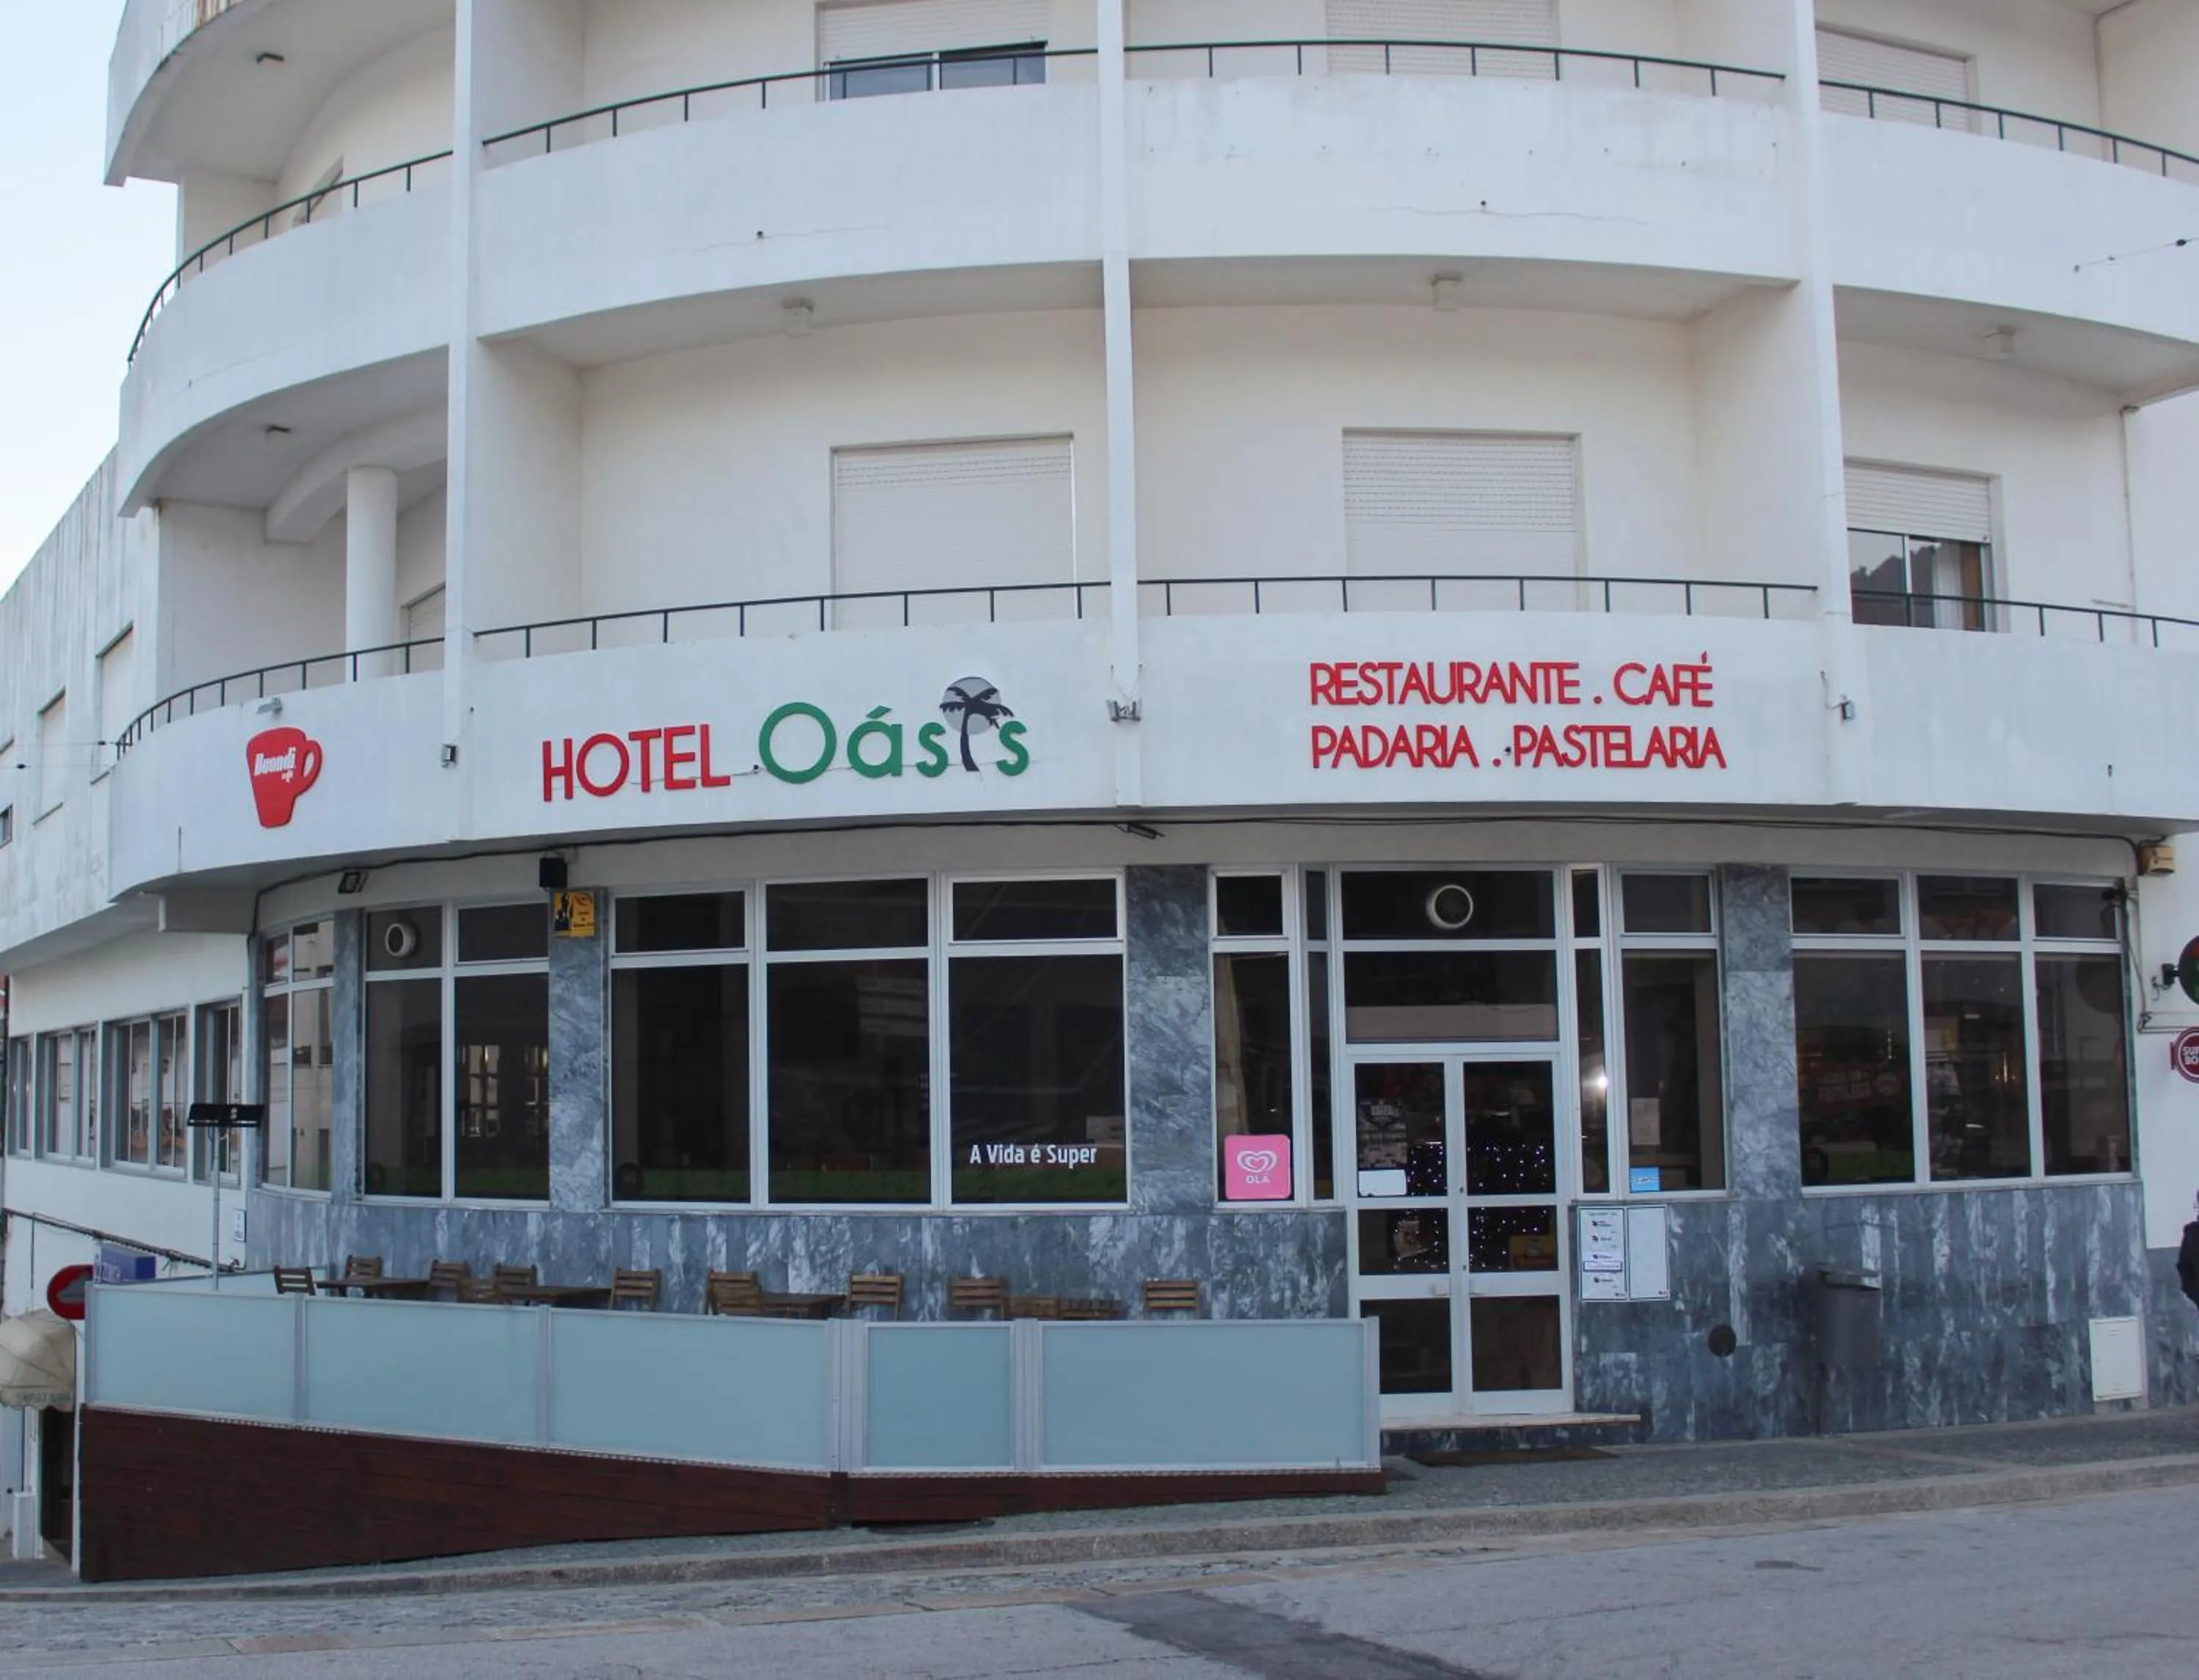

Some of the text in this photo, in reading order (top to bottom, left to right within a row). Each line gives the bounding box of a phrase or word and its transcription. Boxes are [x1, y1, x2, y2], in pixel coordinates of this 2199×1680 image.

[1310, 661, 1580, 705] RESTAURANTE
[1613, 651, 1713, 707] CAFÉ
[542, 723, 731, 802] HOTEL
[1311, 724, 1479, 769] PADARIA
[1513, 724, 1726, 769] PASTELARIA
[969, 1143, 1097, 1169] A Vida é Super
